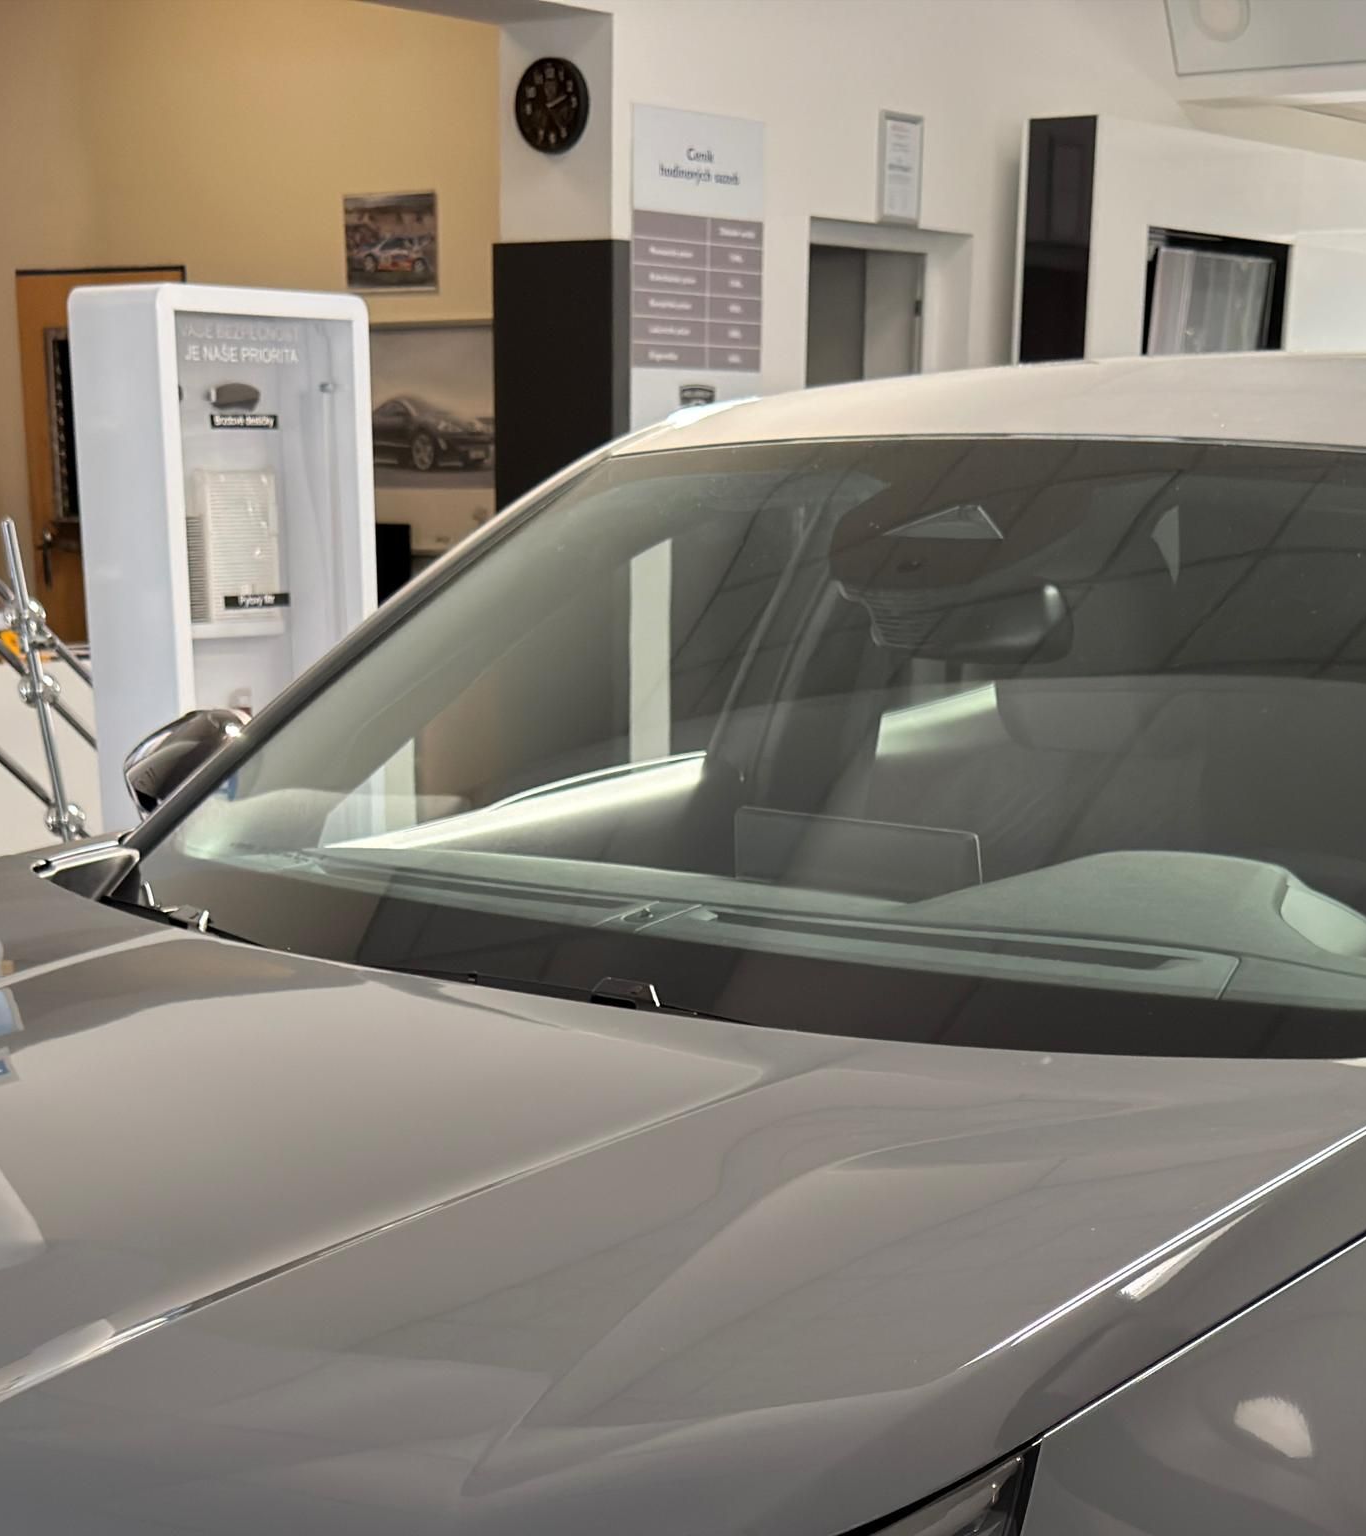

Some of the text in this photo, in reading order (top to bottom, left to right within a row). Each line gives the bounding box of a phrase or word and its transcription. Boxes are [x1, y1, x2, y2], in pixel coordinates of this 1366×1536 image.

[185, 343, 300, 363] JE NAŠE PRIORITA
